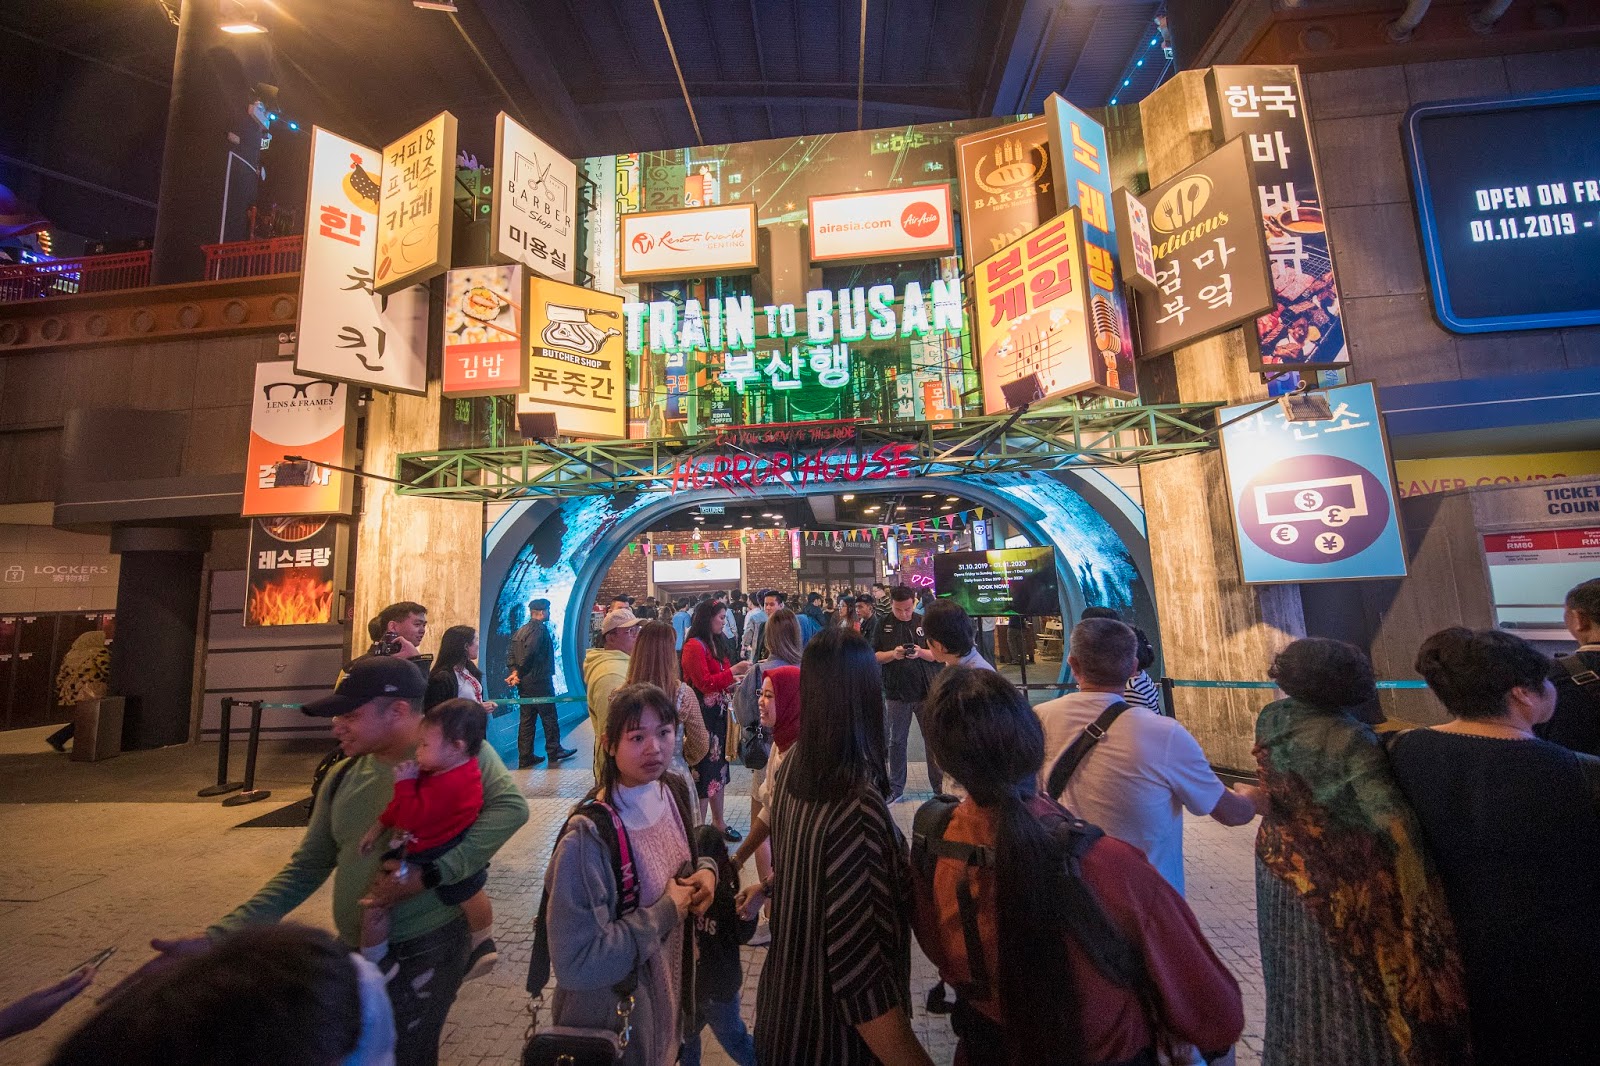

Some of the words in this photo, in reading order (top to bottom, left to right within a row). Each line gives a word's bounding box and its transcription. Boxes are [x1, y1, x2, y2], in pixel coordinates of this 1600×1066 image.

[1225, 85, 1296, 118] 한국
[390, 128, 436, 167] 커피&
[384, 155, 437, 200] 프렌즈
[386, 186, 434, 232] 카페
[508, 180, 571, 229] BARBER
[974, 182, 1051, 210] BAKERY
[1070, 120, 1115, 293] 노래방
[1475, 186, 1531, 211] OPEN
[1537, 183, 1568, 206] ON
[319, 204, 366, 247] 한
[528, 210, 552, 230] Shop
[819, 218, 892, 235] airasia.com
[1470, 213, 1576, 242] 01.11.2019
[509, 224, 567, 272] 미용실
[704, 229, 745, 240] World
[707, 240, 745, 250] GENTING
[986, 220, 1069, 293] 보드
[989, 258, 1073, 328] 게임
[622, 295, 756, 356] TRAIN
[763, 303, 796, 339] TO
[806, 278, 964, 346] BUSAN
[458, 353, 505, 380] 김밥
[542, 348, 581, 365] BUTCHER
[581, 357, 602, 369] SHOP
[718, 344, 850, 395] 부산행
[531, 366, 615, 401] 푸줏간
[266, 400, 288, 409] LENS
[289, 400, 296, 408] &
[298, 397, 334, 407] FRAMES
[807, 427, 833, 442] THIS
[669, 451, 798, 497] HORROR
[801, 441, 920, 490] HOUSE
[1546, 500, 1600, 515] COUN
[258, 547, 331, 570] 레스토랑
[1506, 542, 1534, 550] RM80
[34, 565, 109, 574] LOCKERS
[958, 562, 988, 570] 31.10.2019
